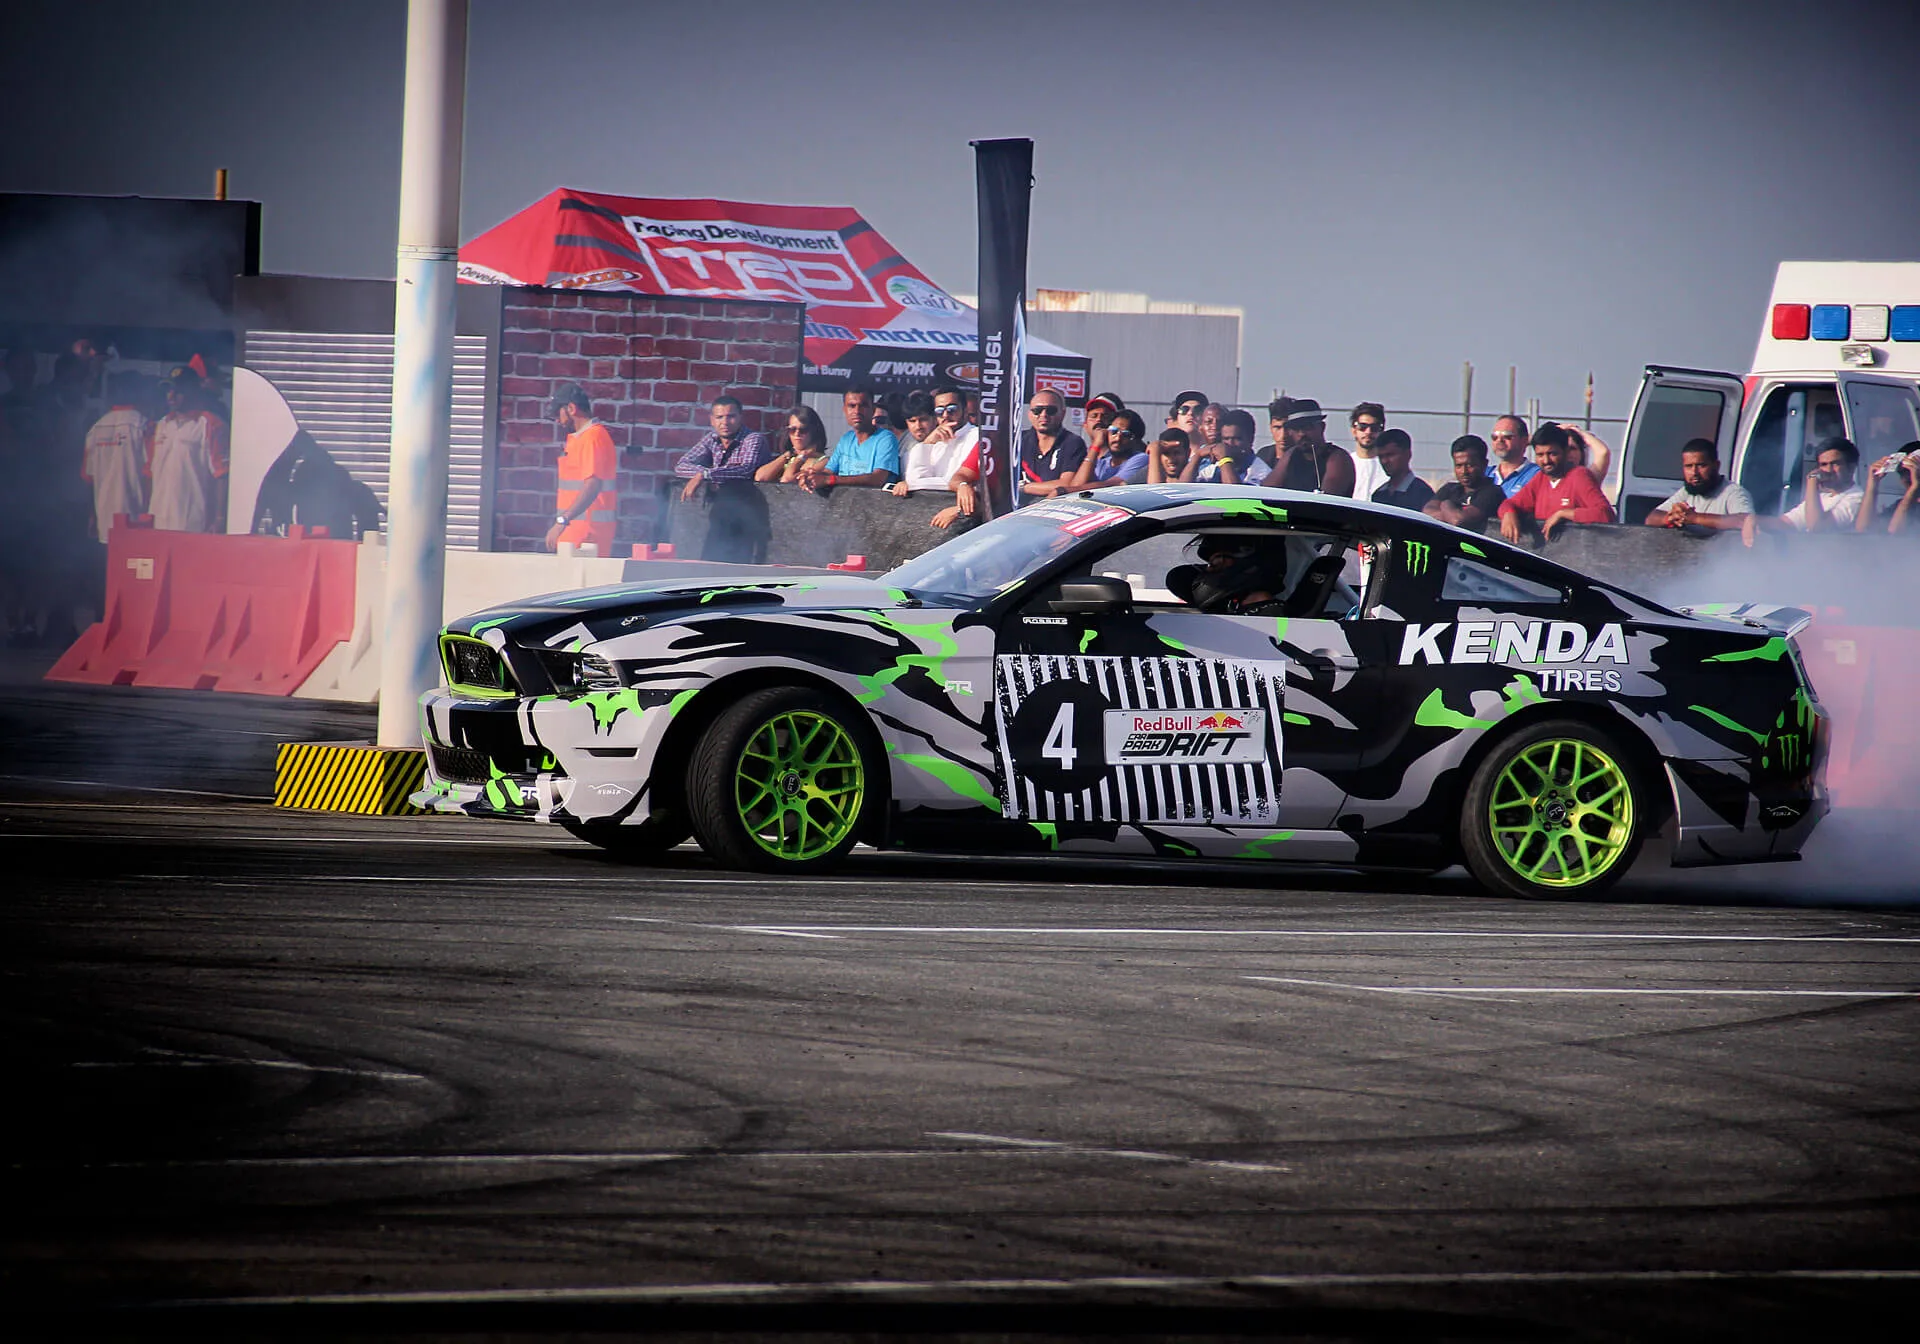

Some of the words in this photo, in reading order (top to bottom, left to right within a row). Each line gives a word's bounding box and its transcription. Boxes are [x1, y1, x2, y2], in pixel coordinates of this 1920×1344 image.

[704, 224, 839, 250] Development
[655, 247, 853, 298] TRD
[821, 365, 852, 379] Bunny
[892, 362, 936, 377] WORK
[1399, 621, 1629, 665] KENDA
[1537, 669, 1621, 693] TIRES
[1133, 717, 1162, 731] Red
[1164, 717, 1192, 731] Bull
[1042, 703, 1077, 770] 4
[1120, 732, 1251, 757] DRIFT
[1122, 740, 1161, 751] PARK
[1127, 733, 1147, 741] CAR
